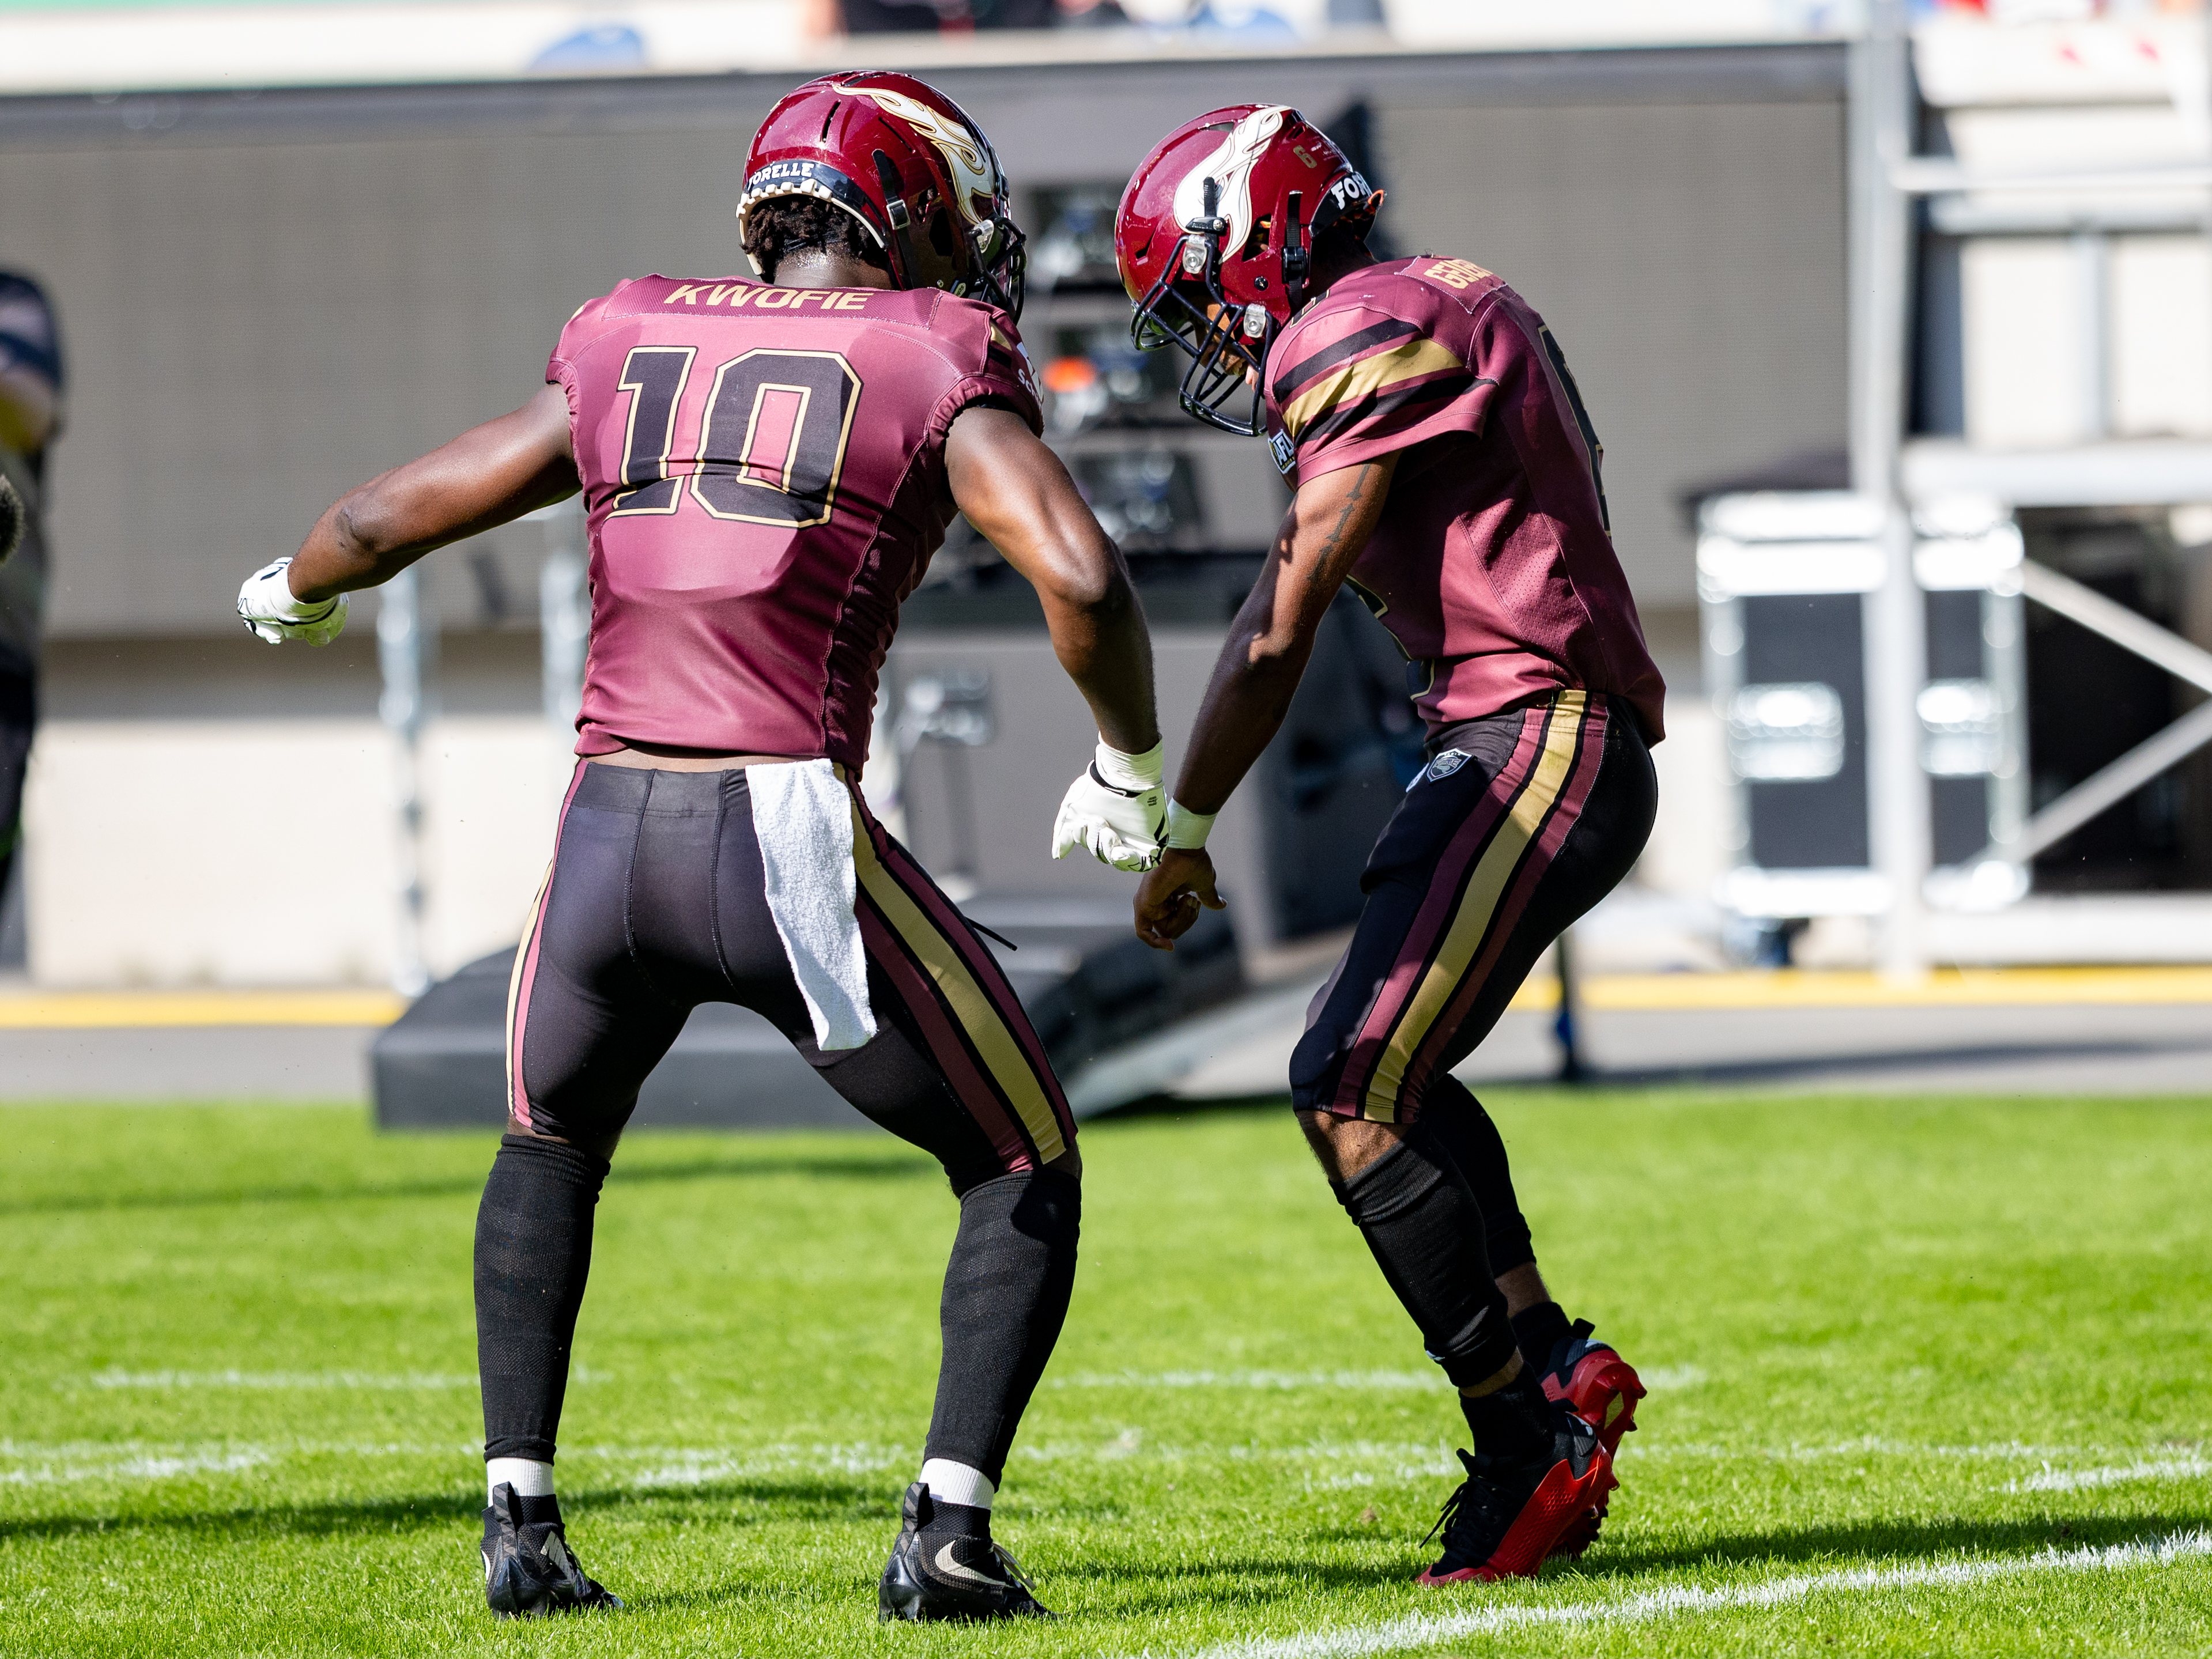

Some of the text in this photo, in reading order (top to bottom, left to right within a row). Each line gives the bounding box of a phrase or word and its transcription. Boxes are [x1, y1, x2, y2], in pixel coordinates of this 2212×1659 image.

[1293, 145, 1318, 169] 6
[663, 284, 874, 310] KWOFIE
[603, 346, 864, 528] 10
